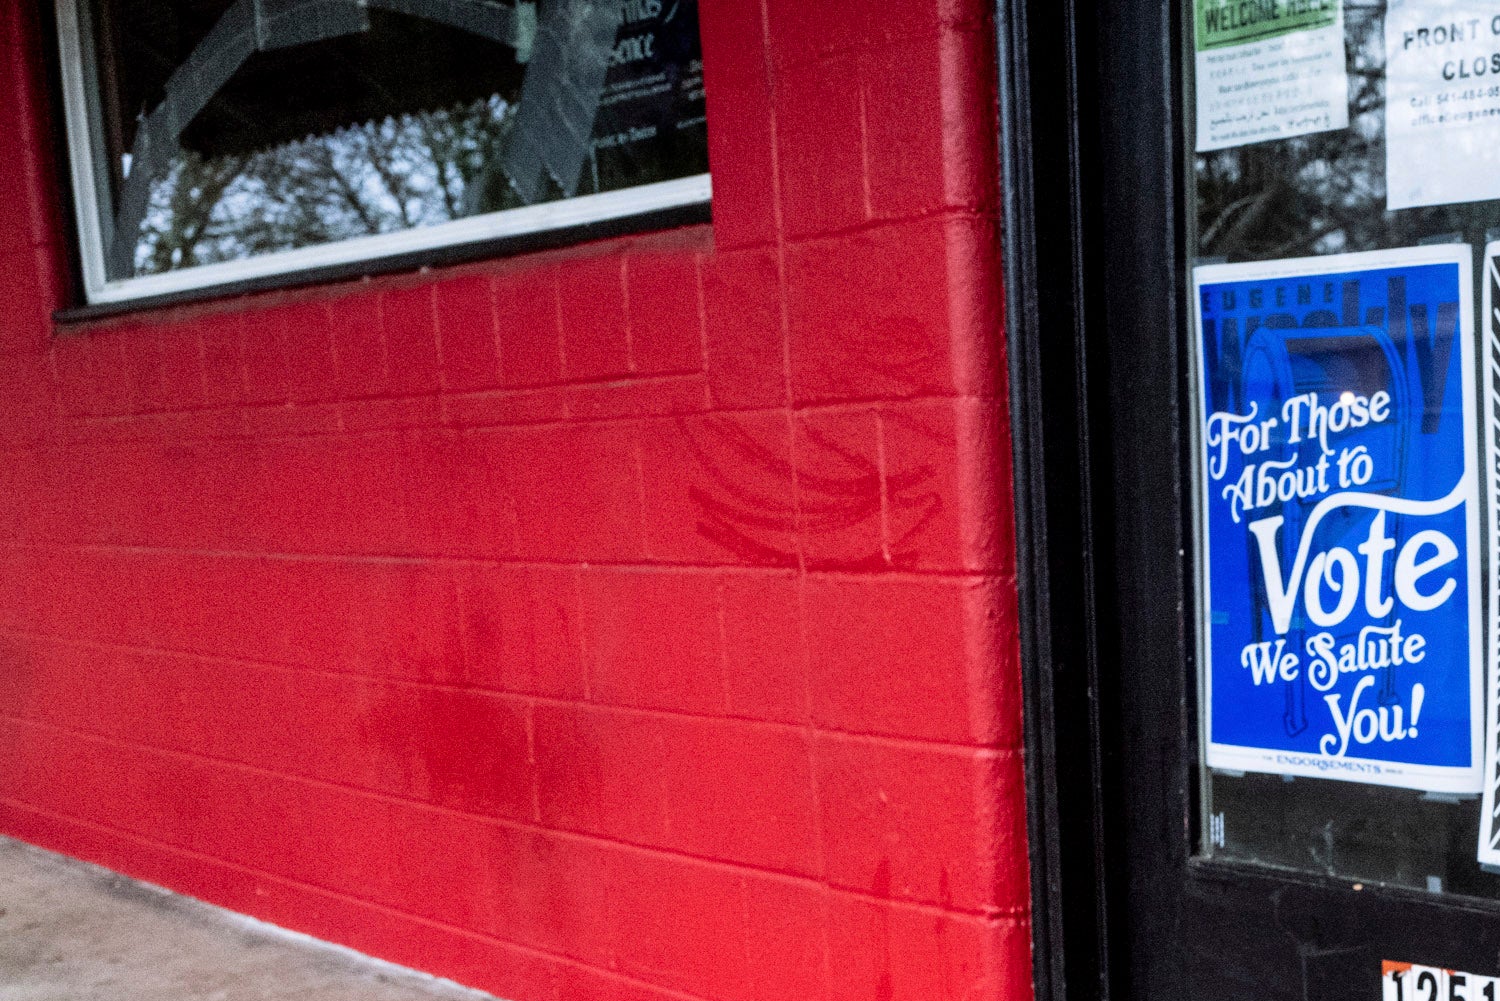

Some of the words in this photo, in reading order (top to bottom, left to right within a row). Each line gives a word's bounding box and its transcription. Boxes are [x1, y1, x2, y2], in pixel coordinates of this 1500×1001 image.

[1402, 19, 1480, 50] FRONT
[1207, 401, 1278, 480] For
[1282, 391, 1391, 456] Those
[1222, 452, 1330, 523] About
[1337, 445, 1374, 486] to
[1248, 472, 1467, 635] Vote
[1241, 639, 1299, 686] We
[1306, 619, 1426, 691] Salute
[1319, 675, 1425, 757] You!
[1276, 754, 1382, 774] ENDORSEMENTS
